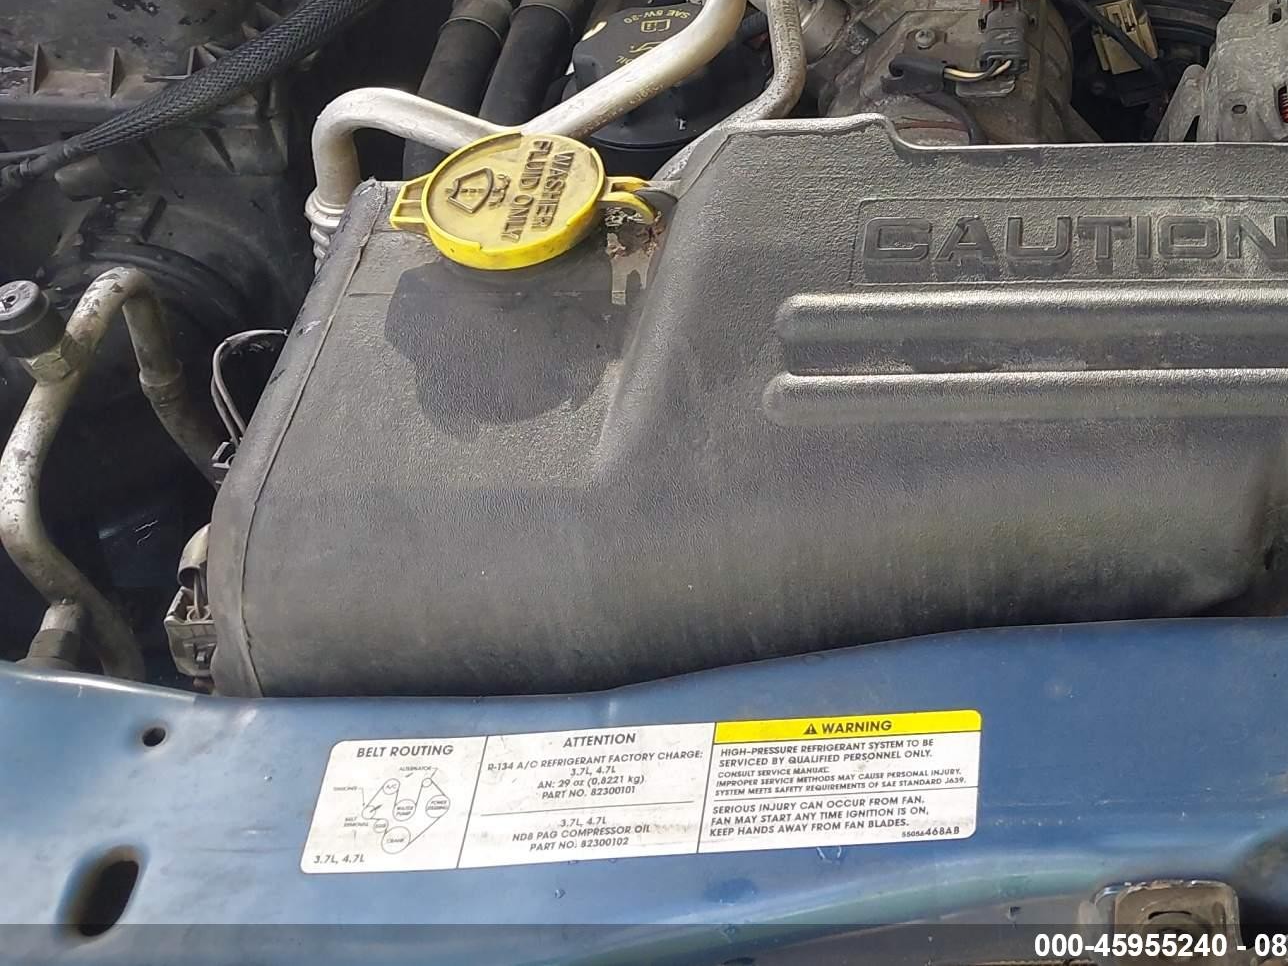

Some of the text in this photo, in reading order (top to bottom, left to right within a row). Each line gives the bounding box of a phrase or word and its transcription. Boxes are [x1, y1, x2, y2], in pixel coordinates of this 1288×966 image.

[665, 10, 690, 19] SAE
[500, 140, 554, 243] FLUID ONLY
[531, 150, 576, 232] WASHER
[821, 720, 892, 734] WARNING
[563, 733, 637, 748] ATTENTION
[720, 738, 934, 757] HIGH-PRESSURE REFRIGERANT SYSTEM TO BE
[357, 745, 454, 758] BELT ROUTING
[719, 749, 933, 768] SERVICED BY QUALIFIED PERSONNEL ONLY.
[487, 750, 703, 772] R-134 A/C REFRIGERANT FACTORY CHARGE:
[570, 766, 616, 777] 3.7L, 4.7L
[716, 779, 758, 787] IMPROPER
[761, 777, 794, 786] SERVICE
[796, 775, 835, 784] METHODS
[838, 773, 855, 781] MAY
[858, 772, 885, 780] CAUSE
[887, 770, 928, 779] PERSONAL
[717, 770, 755, 779] CONSULT
[757, 768, 791, 777] SERVICE
[557, 779, 571, 788] 29
[627, 774, 645, 786] kg)
[715, 788, 745, 797] SYSTEM
[748, 787, 772, 795] MEETS
[775, 785, 803, 794] SAFETY
[805, 782, 866, 792] REQUIREMENTS
[868, 781, 879, 789] OF
[881, 780, 896, 788] SAE
[898, 778, 942, 787] STANDARD
[542, 786, 636, 799] PART NO. 82300101
[713, 804, 756, 814] SERIOUS
[759, 802, 797, 812] INJURY
[800, 801, 823, 810] CAN
[826, 798, 866, 809] OCCUR
[868, 797, 898, 806] FROM
[586, 817, 606, 826] 4.7L
[711, 817, 732, 827] FAN
[734, 815, 758, 825] MAY
[760, 814, 792, 823] START
[794, 812, 817, 821] ANY
[820, 810, 843, 820] TIME
[846, 808, 894, 819] IGNITION
[897, 807, 906, 816] IS
[536, 830, 558, 840] PAG
[561, 825, 632, 838] COMPRESSOR
[634, 825, 650, 834] OIL
[709, 818, 910, 837] KEEP HANDS AWAY FROM FAN BLADES.
[529, 842, 555, 851] PART
[581, 837, 629, 848] 82300102
[313, 854, 365, 865] 3.7L, 4.7L
